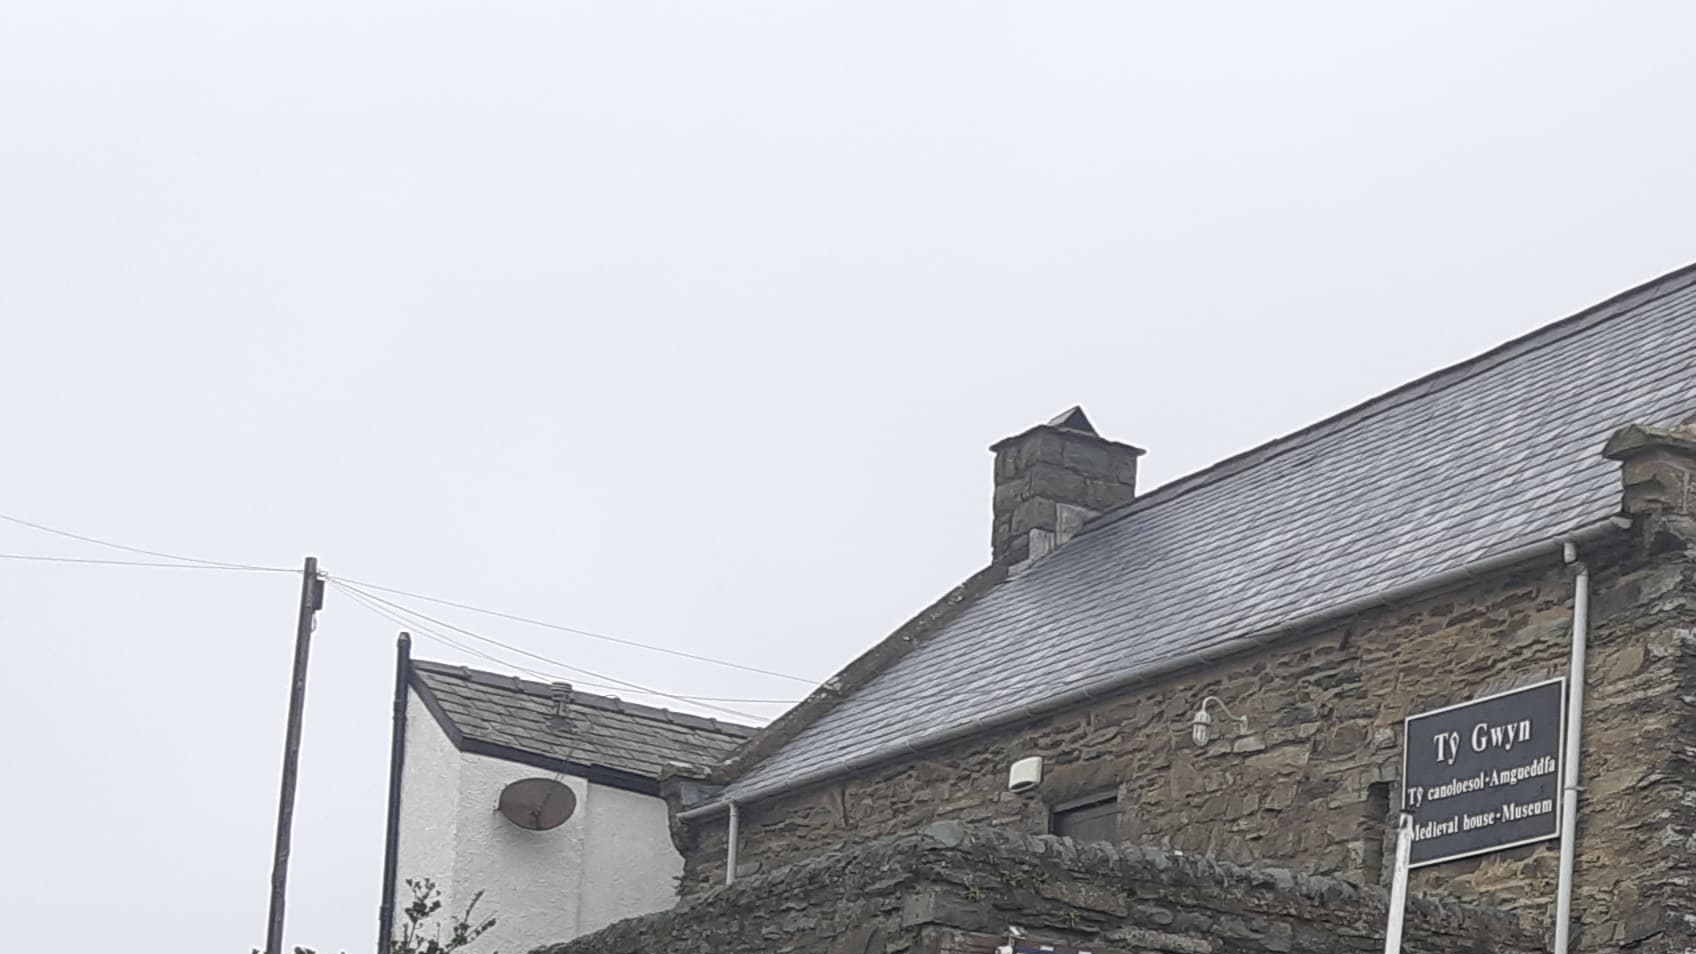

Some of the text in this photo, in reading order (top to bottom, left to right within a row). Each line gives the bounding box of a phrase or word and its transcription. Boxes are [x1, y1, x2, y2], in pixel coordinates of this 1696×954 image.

[1433, 719, 1531, 765] Tŷ Gwyn
[1411, 815, 1459, 842] Medieval
